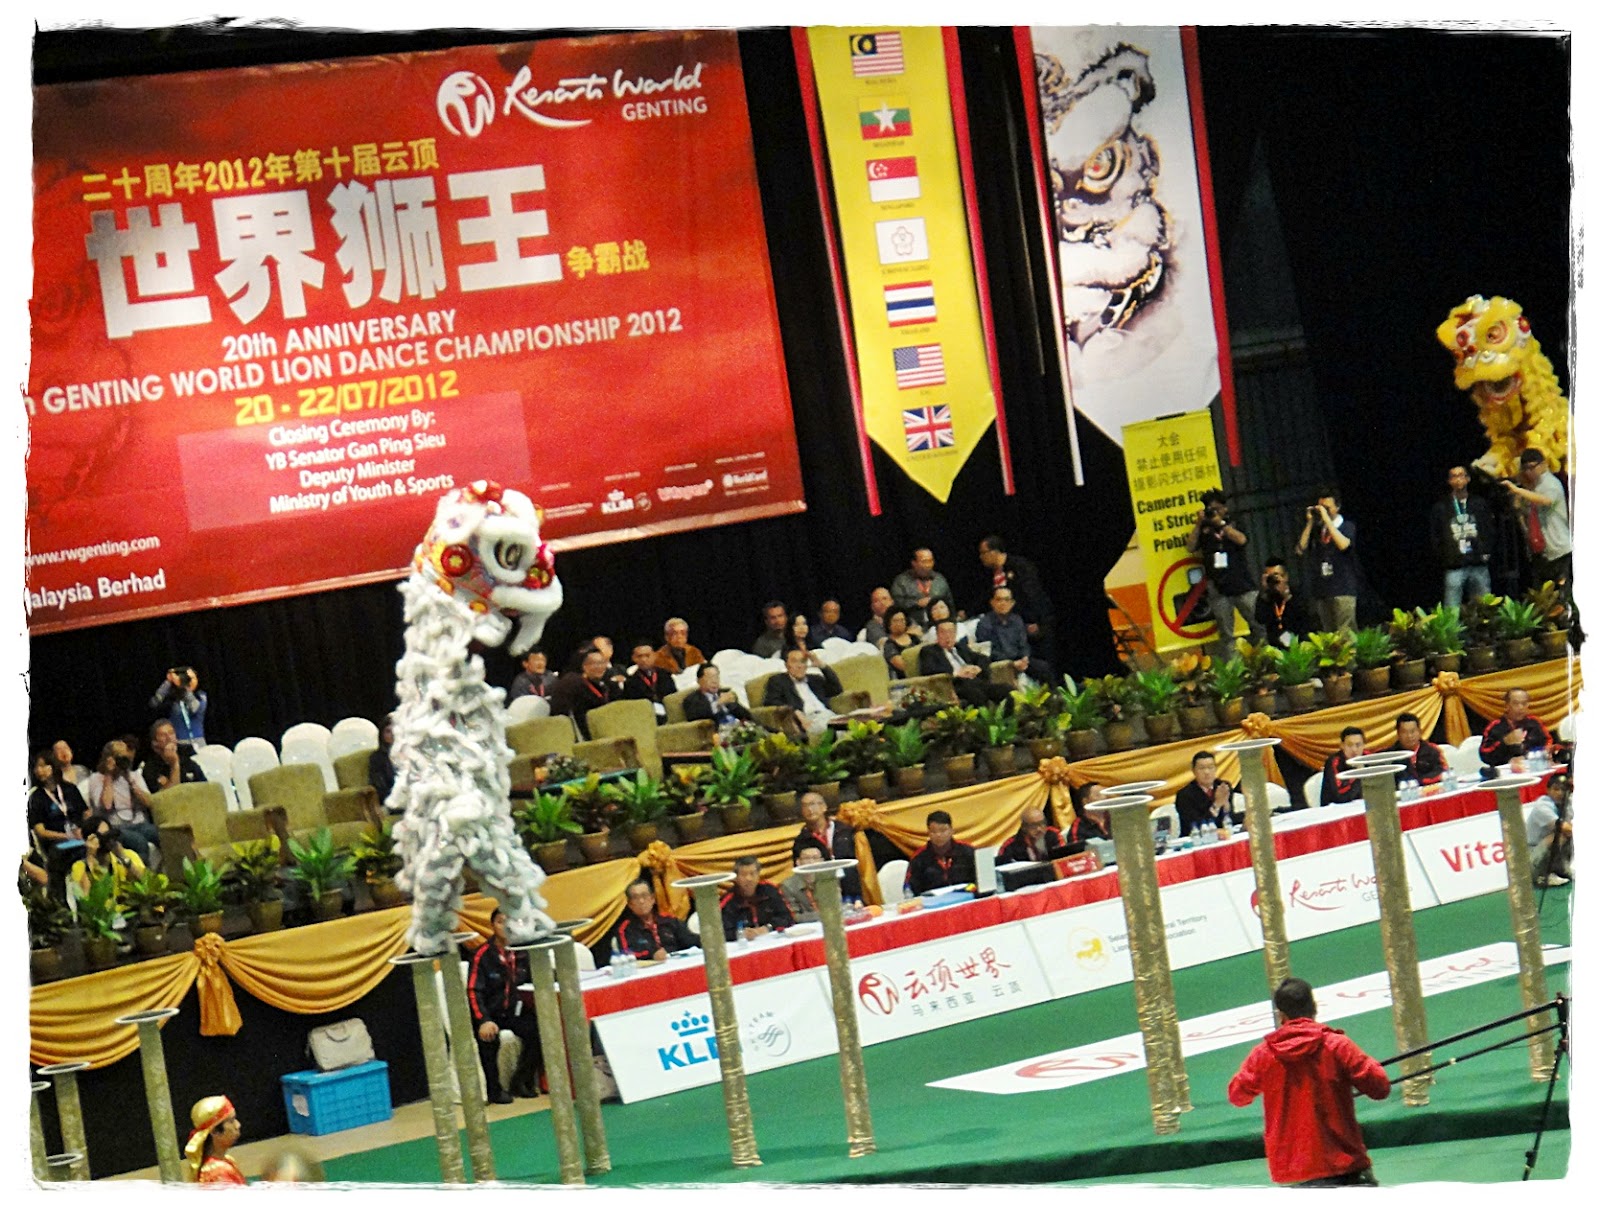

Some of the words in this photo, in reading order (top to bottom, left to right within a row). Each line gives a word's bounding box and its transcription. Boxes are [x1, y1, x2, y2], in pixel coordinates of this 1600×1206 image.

[502, 65, 607, 128] Resorts
[613, 62, 703, 98] World
[621, 97, 708, 122] GENTING
[82, 138, 440, 202] 二十周年2012年第十届云顶
[84, 164, 563, 340] 世界狮王
[567, 239, 650, 279] 争霸战
[221, 333, 278, 362] 20th
[285, 308, 457, 354] ANNIVERSARY
[43, 374, 165, 415] GENTING
[170, 365, 265, 398] WORLD
[271, 354, 332, 387] LION
[340, 341, 429, 377] DANCE
[434, 315, 621, 364] CHAMPIONSHIP
[627, 306, 684, 338] 2012
[234, 393, 275, 427] 20
[297, 369, 460, 418] 22/07/2012
[268, 425, 329, 447] Closing
[329, 412, 409, 438] Ceremony
[410, 408, 436, 430] By:
[1157, 431, 1181, 448] 大会
[265, 452, 288, 471] YB
[288, 447, 346, 468] Senator
[346, 442, 378, 461] Gan
[378, 436, 413, 457] Ping
[413, 432, 447, 451] Sieu
[299, 466, 355, 489] Deputy
[356, 457, 416, 479] Minister
[269, 492, 331, 515] Ministry
[331, 484, 350, 505] of
[348, 481, 393, 502] Youth
[393, 479, 407, 496] &
[407, 473, 455, 496] Sports
[1137, 494, 1186, 515] Camera
[1152, 517, 1164, 532] is
[1165, 511, 1198, 529] Stric
[97, 567, 167, 599] Berhad
[1289, 878, 1348, 911] Resorts
[904, 946, 1012, 1000] 云顶世界
